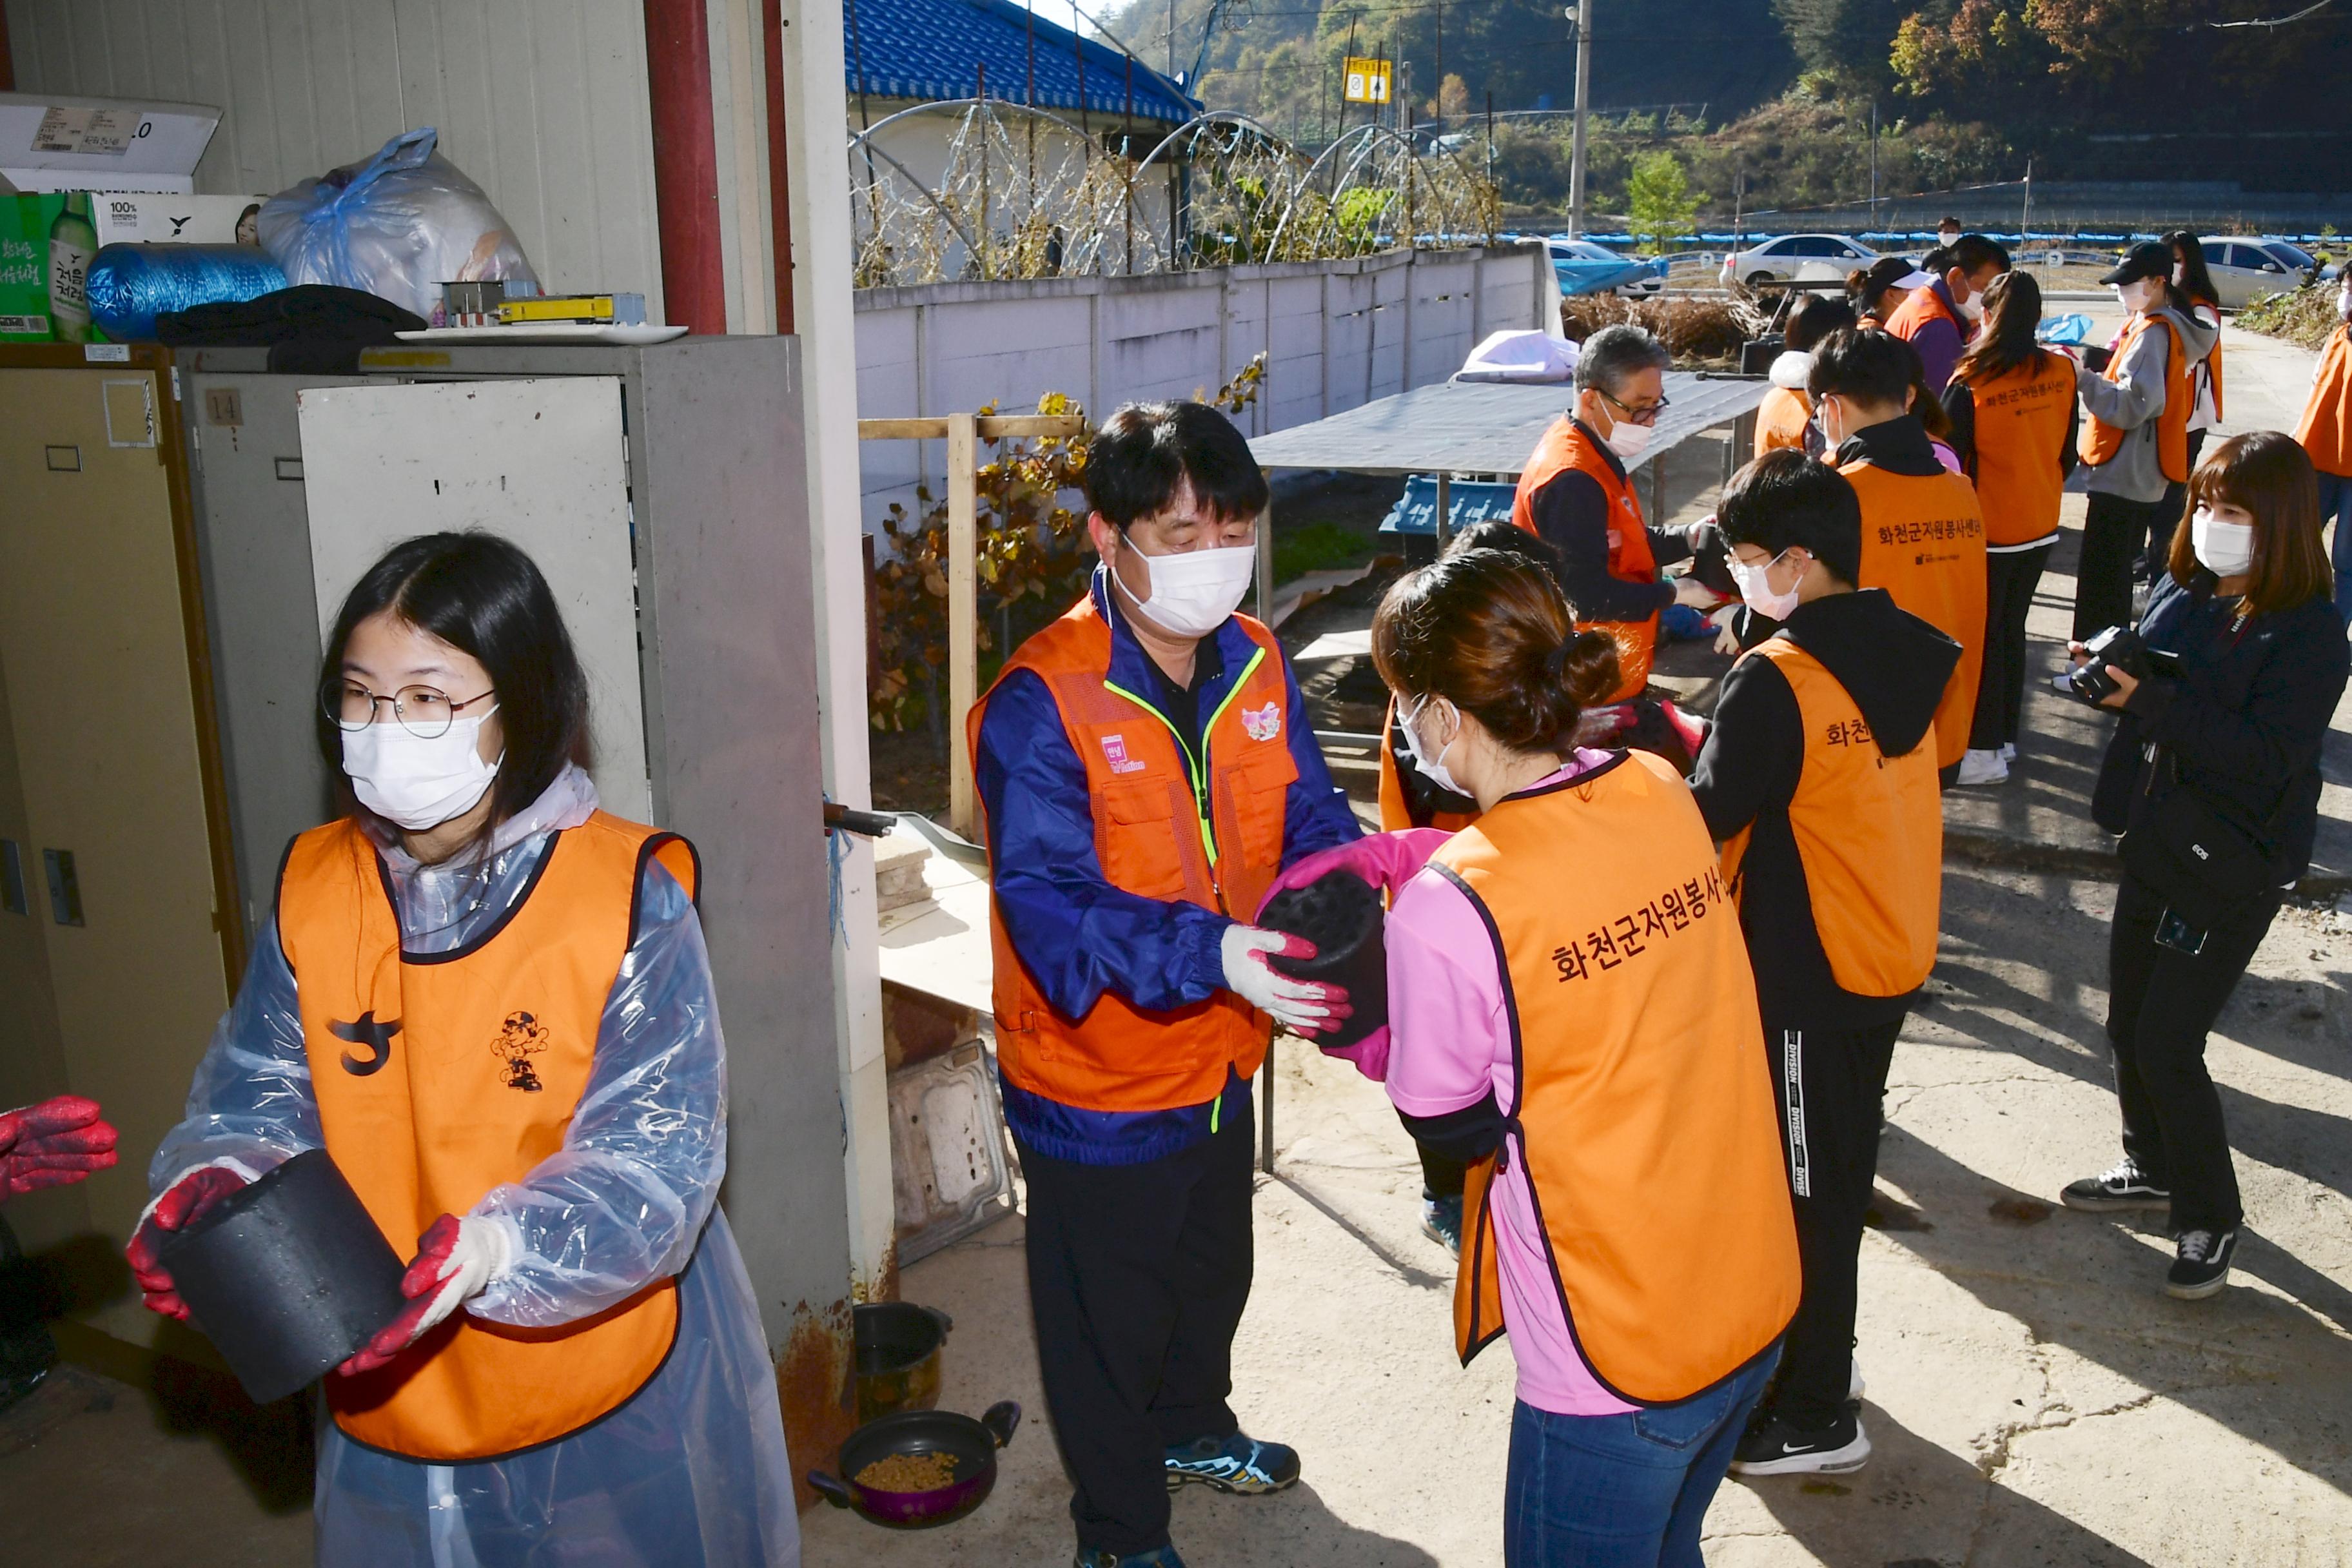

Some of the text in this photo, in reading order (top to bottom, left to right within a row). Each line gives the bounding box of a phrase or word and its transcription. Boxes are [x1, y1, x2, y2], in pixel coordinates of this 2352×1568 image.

[110, 202, 137, 212] 100%
[57, 260, 83, 285] 처음
[2192, 844, 2209, 860] EOS
[1551, 863, 1730, 983] 화천군자원봉사
[1788, 1043, 1798, 1084] DIVISION
[1790, 1106, 1801, 1146] DIVISION
